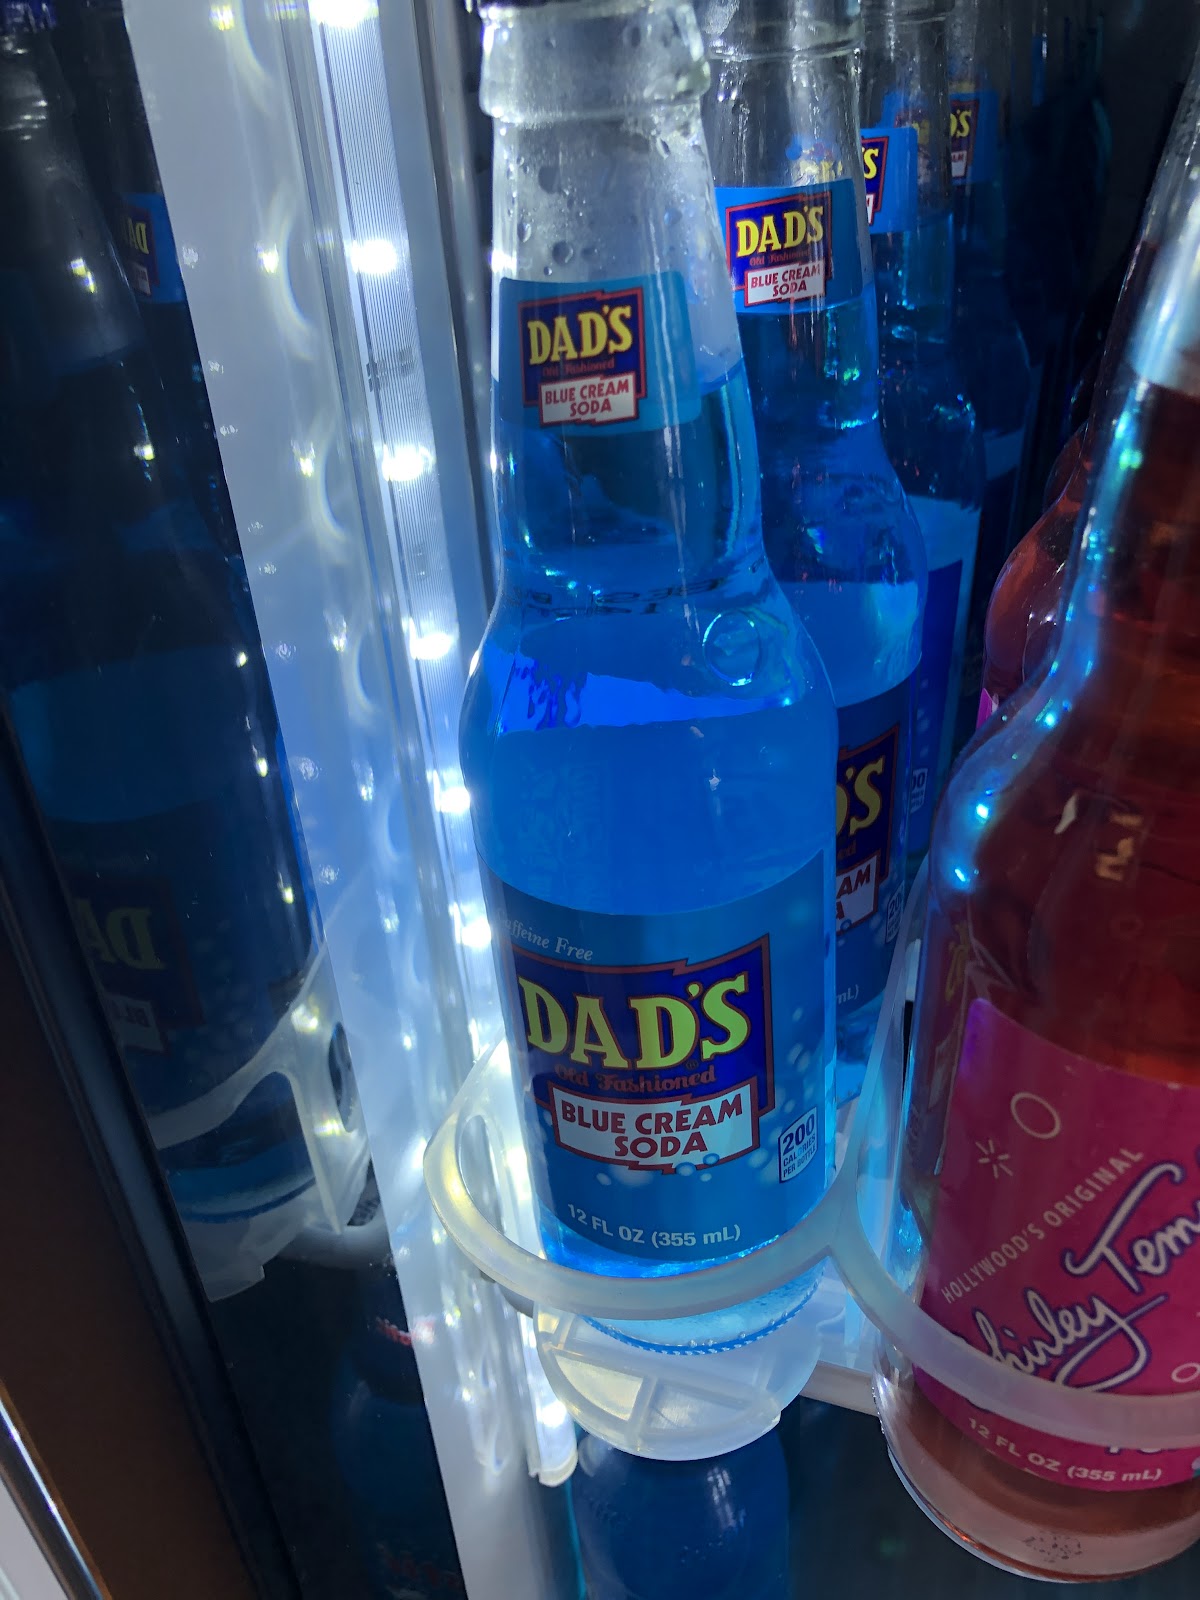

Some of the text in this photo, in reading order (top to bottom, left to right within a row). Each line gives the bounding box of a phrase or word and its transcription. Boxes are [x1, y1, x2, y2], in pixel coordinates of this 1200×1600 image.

[736, 205, 824, 257] DAD'S
[750, 264, 821, 289] BLUE CREAM
[772, 280, 807, 297] SODA
[527, 304, 633, 366] DAD'S
[545, 379, 630, 405] BLUE CREAM
[570, 398, 612, 417] SODA
[554, 936, 594, 961] Free
[518, 974, 750, 1069] DAD'S
[554, 1063, 717, 1093] Old Fashioned
[561, 1093, 743, 1136] BLUE CREAM
[782, 1113, 815, 1156] 200
[614, 1131, 708, 1159] SODA
[783, 1133, 816, 1167] CALORIES
[783, 1163, 796, 1178] PER
[567, 1203, 742, 1249] 12 FL OZ (355 mL)
[940, 1148, 1145, 1304] HOLLYWOOD'S ORIGINAL
[1064, 1162, 1200, 1294] Tem
[972, 1287, 1169, 1393] hirley
[968, 1417, 1163, 1483] 12 FL OZ (355 mL)
